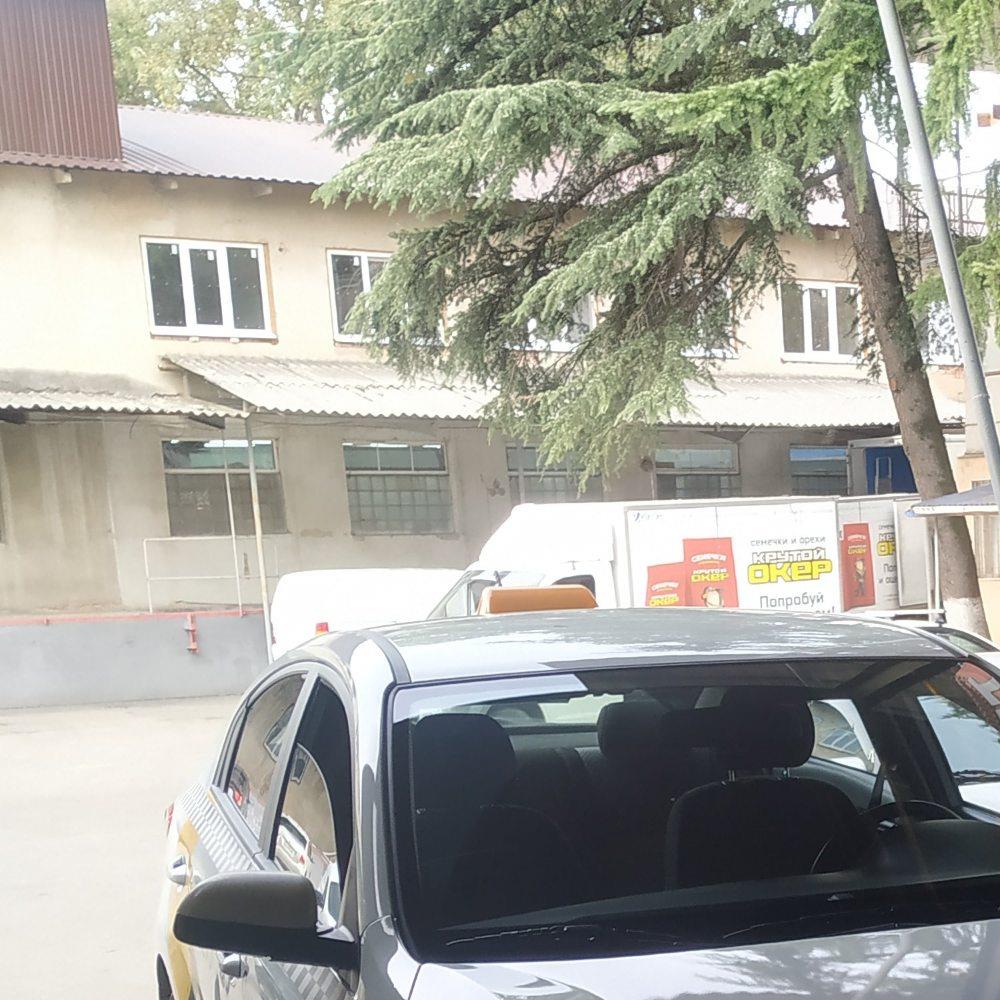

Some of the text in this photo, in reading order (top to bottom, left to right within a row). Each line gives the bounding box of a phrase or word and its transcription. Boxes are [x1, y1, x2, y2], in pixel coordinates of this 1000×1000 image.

[750, 538, 788, 547] семечки
[799, 535, 826, 544] орехи
[760, 592, 824, 609] Попробуй
